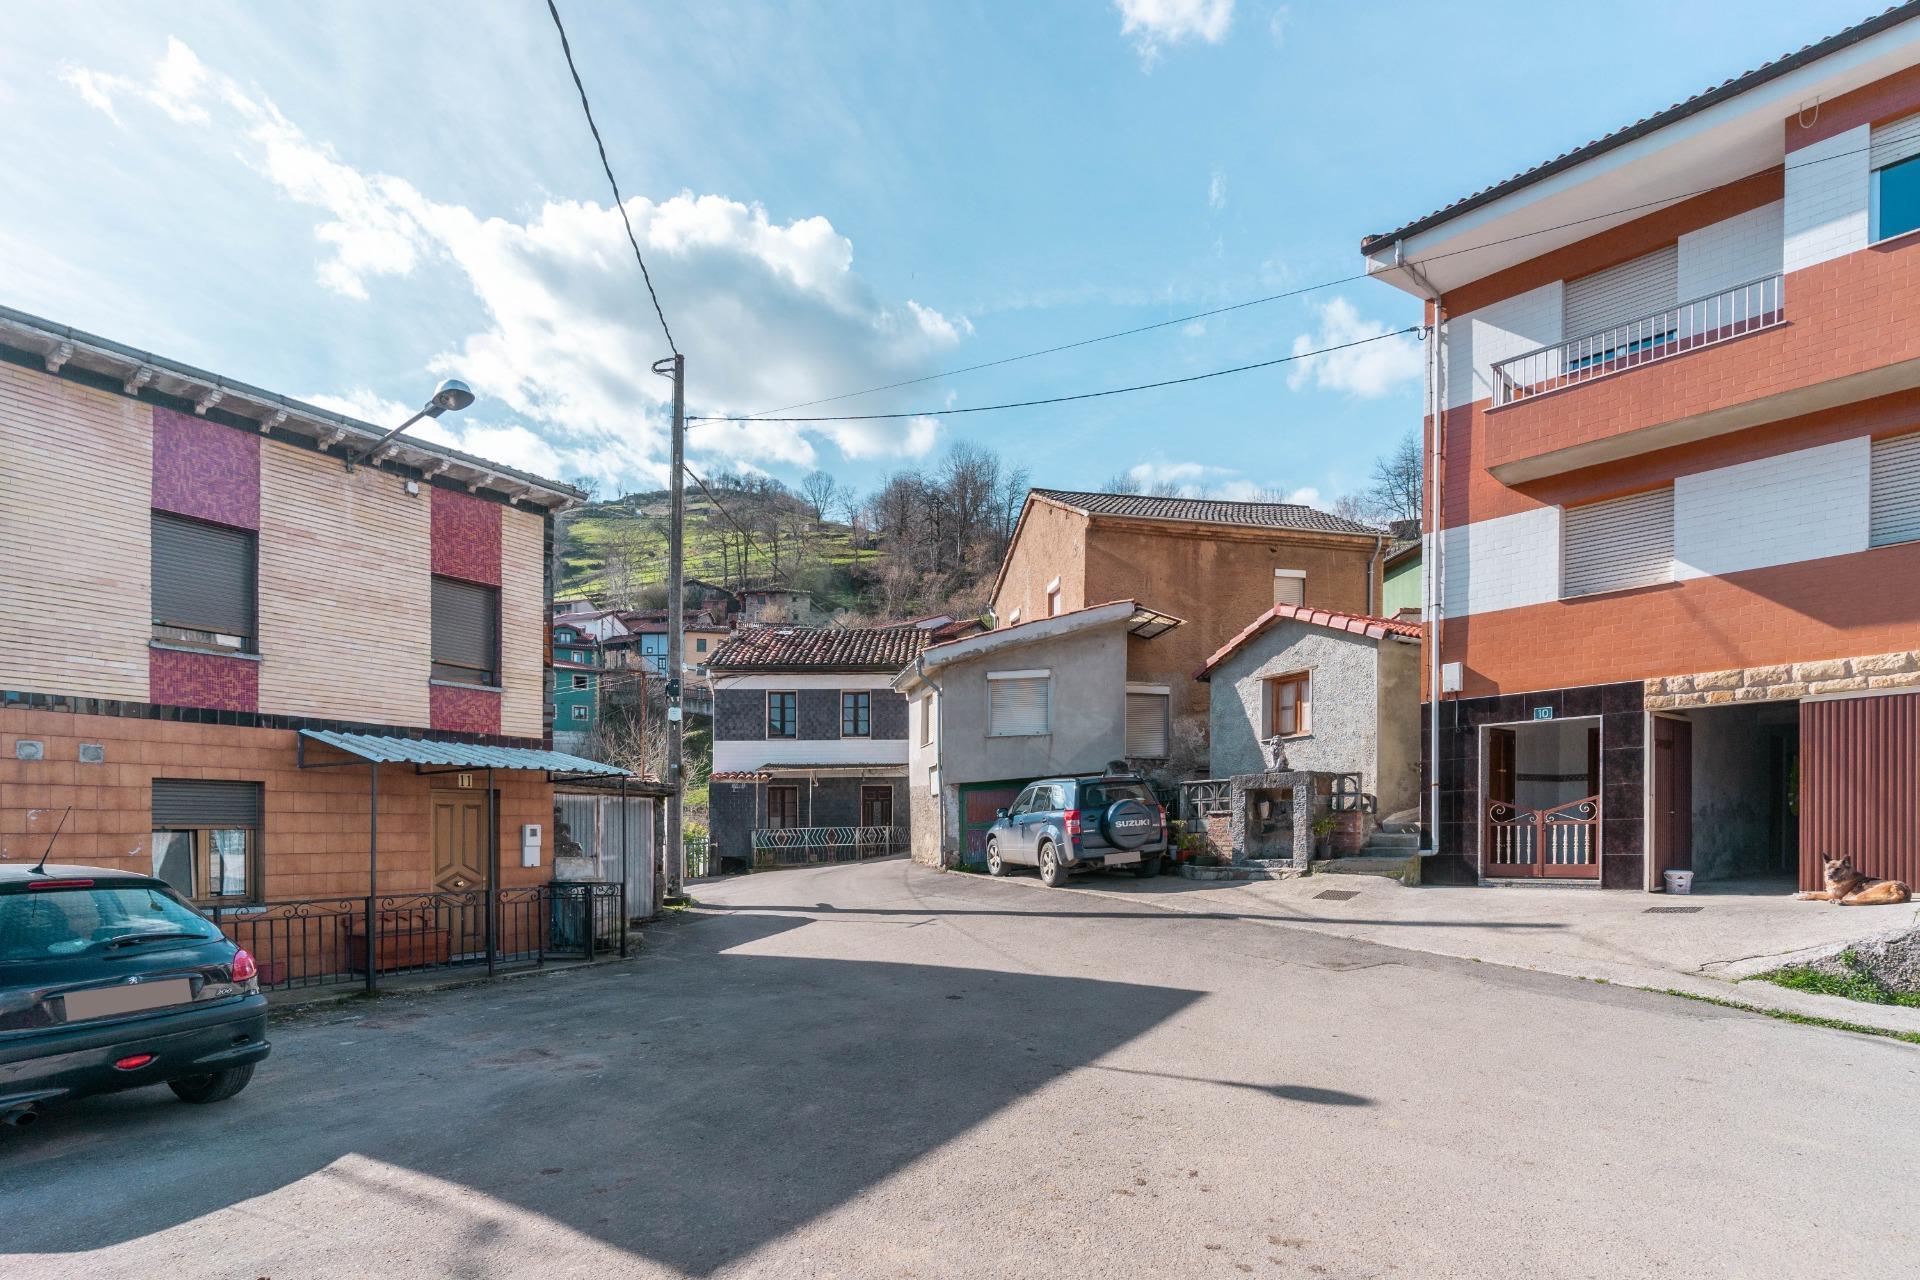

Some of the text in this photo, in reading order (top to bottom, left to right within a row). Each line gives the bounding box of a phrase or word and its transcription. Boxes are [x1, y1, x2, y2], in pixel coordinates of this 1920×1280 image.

[1538, 709, 1549, 718] 10
[460, 775, 471, 786] 11
[1115, 818, 1150, 828] SUZUKI
